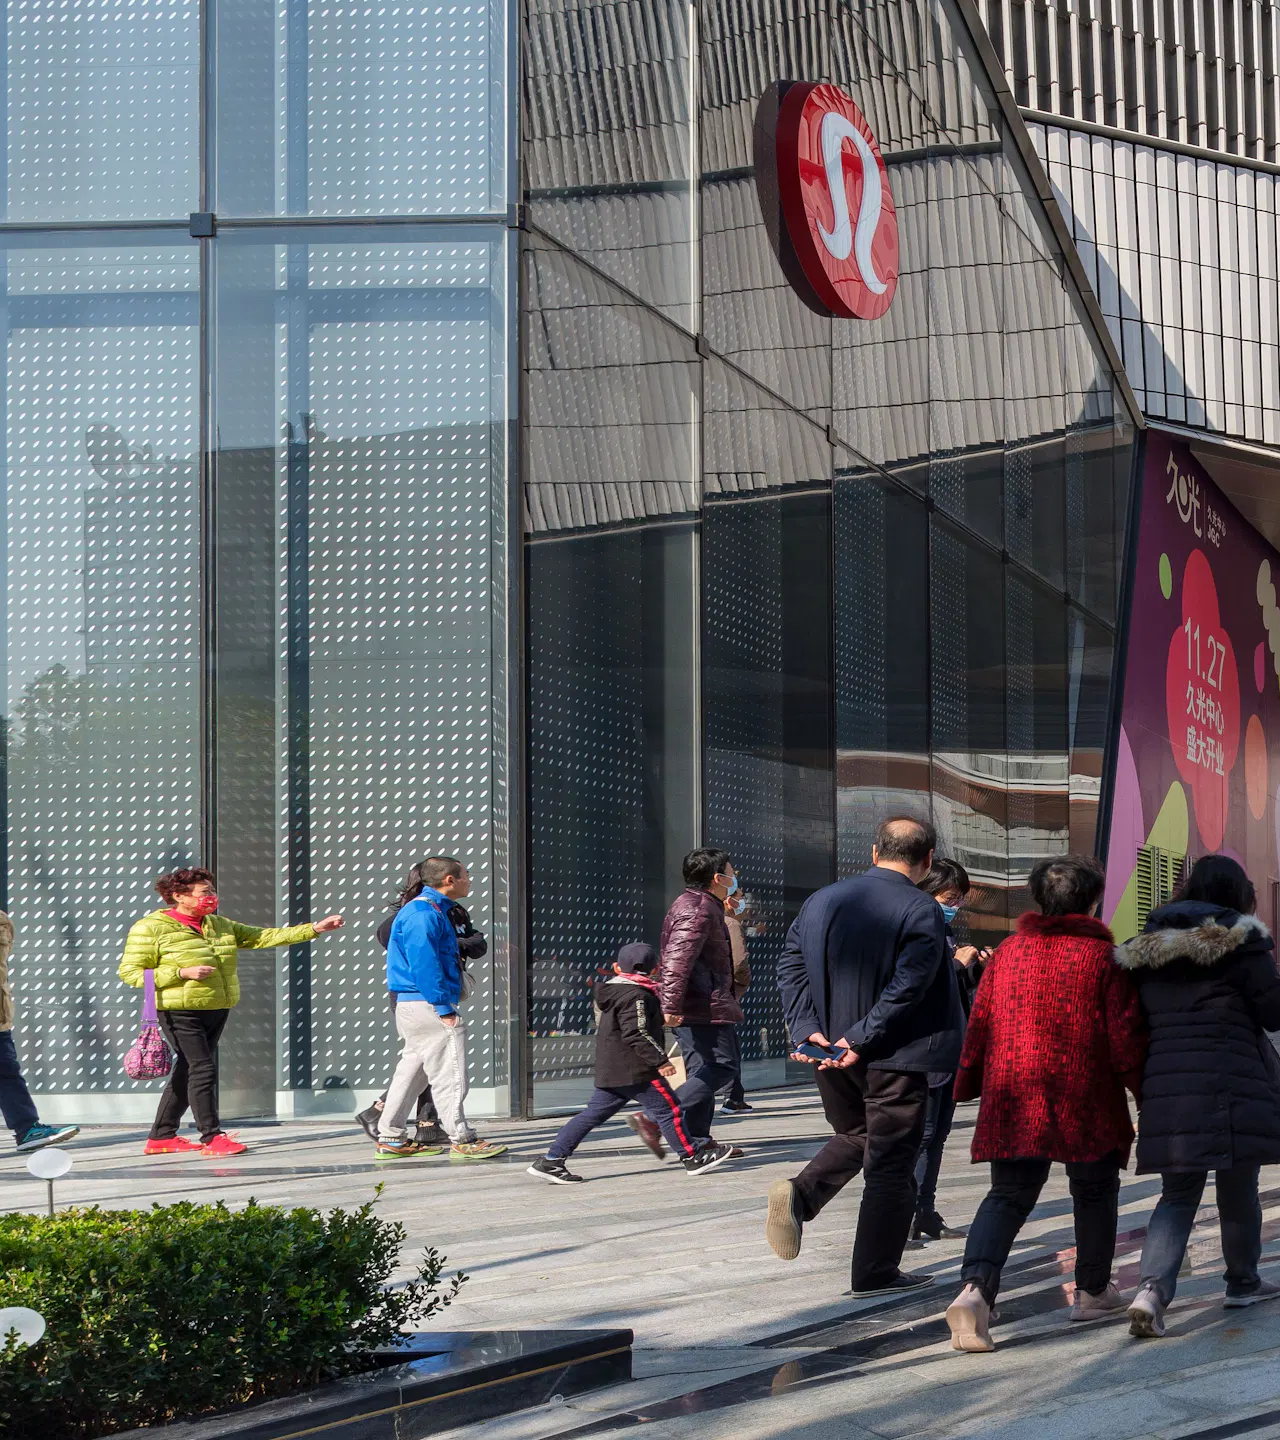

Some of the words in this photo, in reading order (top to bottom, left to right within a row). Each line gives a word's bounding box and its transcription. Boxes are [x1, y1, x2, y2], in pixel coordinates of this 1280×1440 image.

[1166, 450, 1202, 538] 久光
[1207, 504, 1226, 537] 久光中心
[1207, 524, 1220, 548] JGC
[1184, 616, 1226, 692] 11.27
[1186, 679, 1225, 736] 久光中心
[1186, 725, 1225, 776] 盛大开业
